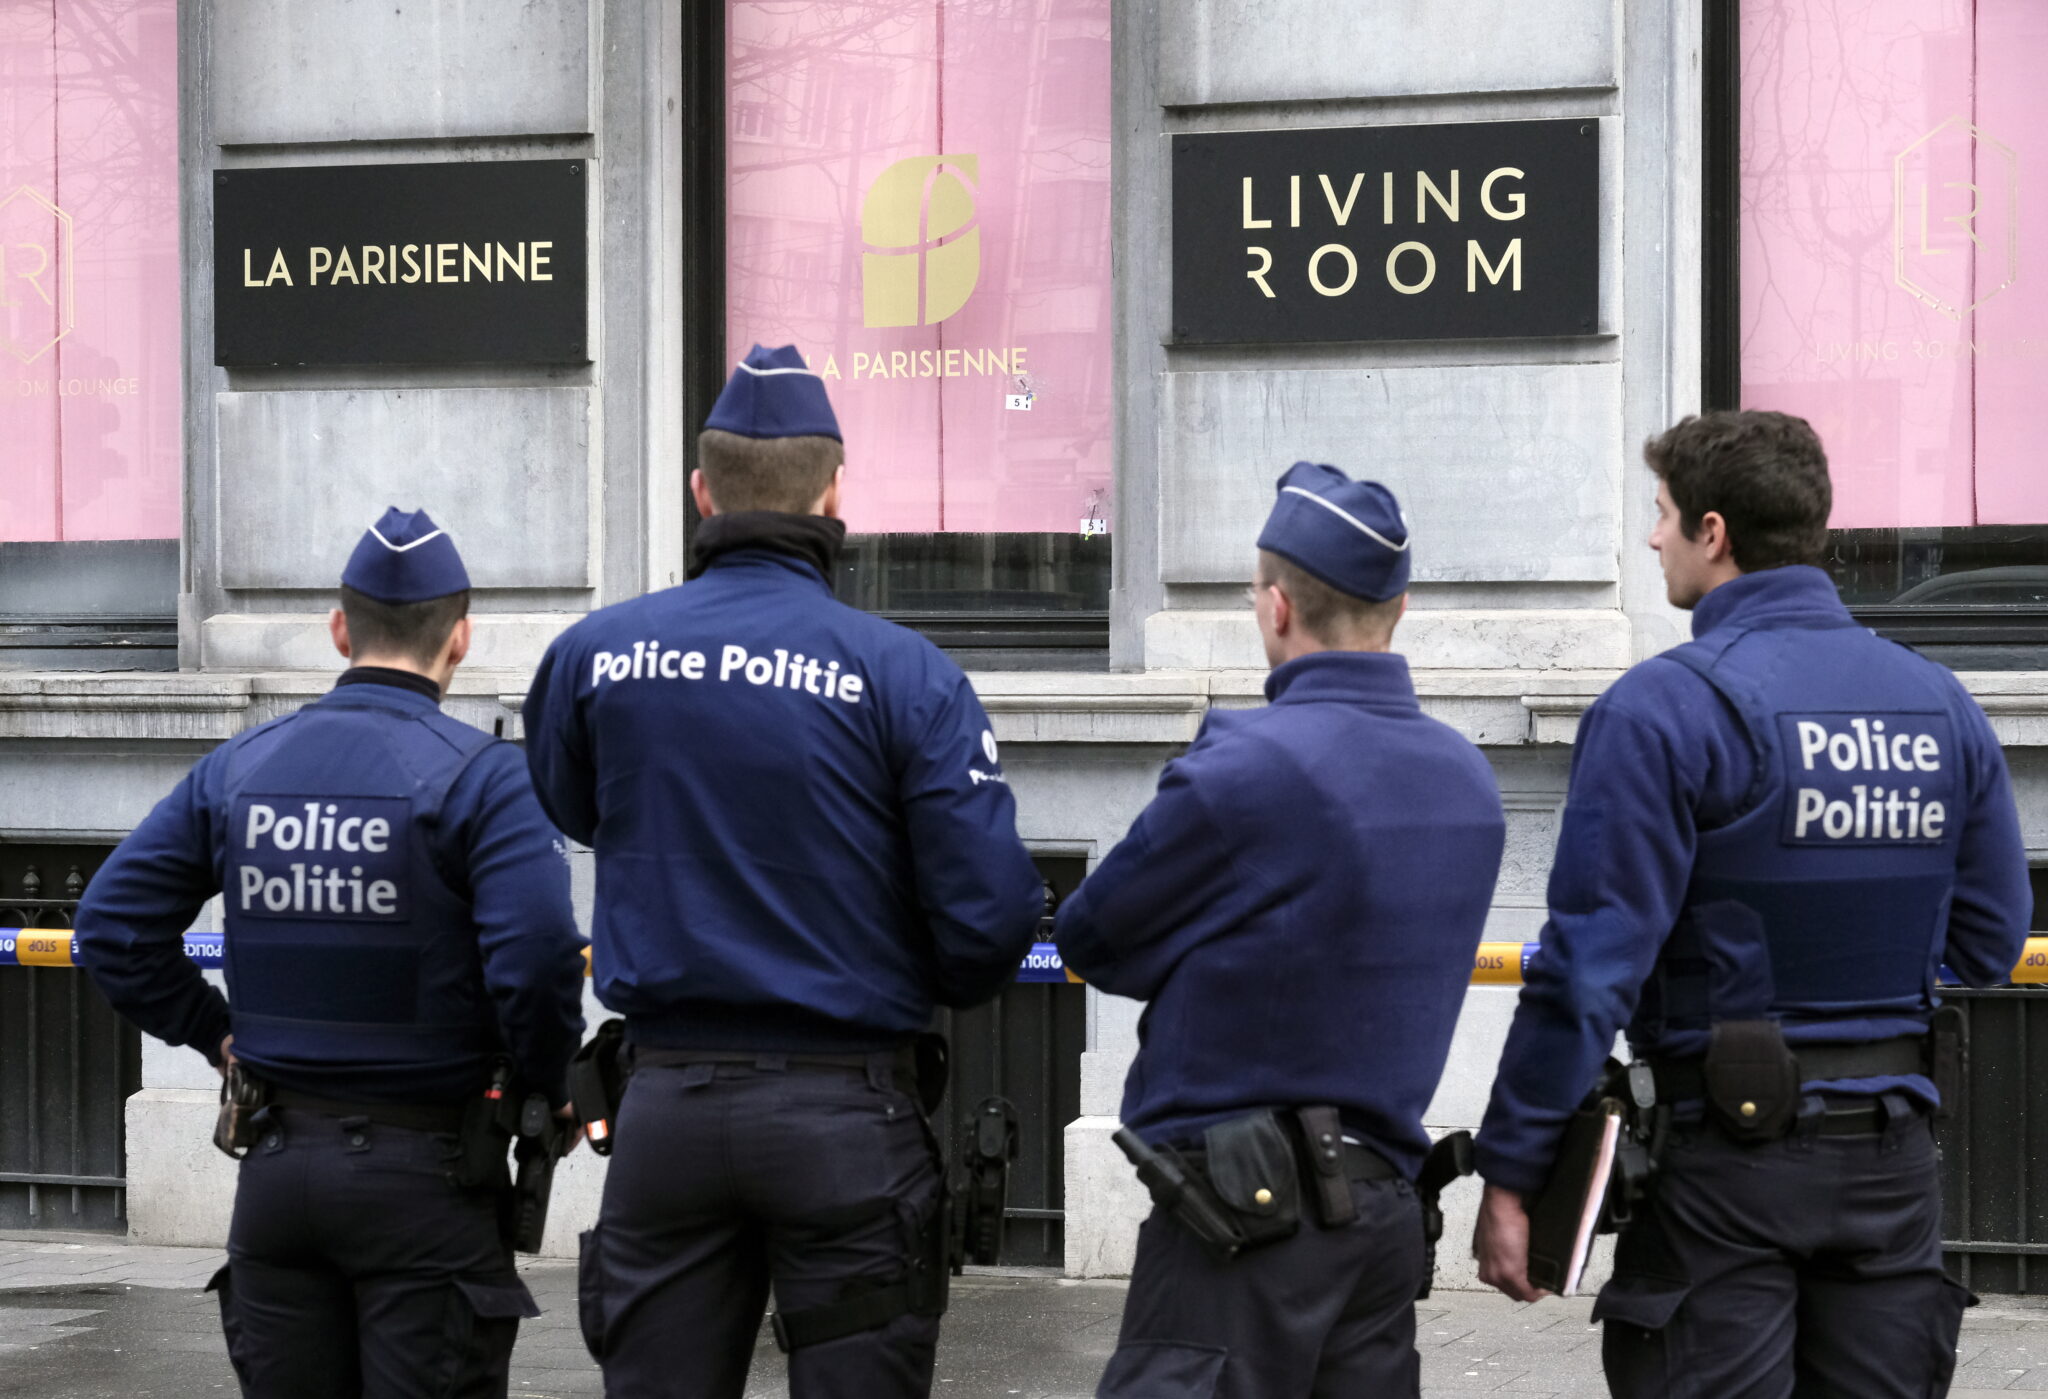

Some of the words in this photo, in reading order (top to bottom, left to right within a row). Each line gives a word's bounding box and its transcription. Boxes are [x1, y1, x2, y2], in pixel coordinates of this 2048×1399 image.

[1242, 166, 1527, 230] LIVING
[243, 246, 294, 288] LA
[309, 240, 553, 286] PARISIENNE
[1246, 237, 1522, 298] ROOM
[853, 347, 1028, 380] PARISIENNE
[1815, 341, 1899, 363] LIVING
[59, 377, 139, 396] LOUNGE
[592, 640, 706, 688] Police
[719, 645, 863, 703] Politie
[1797, 718, 1941, 772] Police
[245, 802, 391, 853] Police
[1795, 785, 1945, 839] Politie
[240, 863, 397, 915] Politie
[28, 940, 57, 953] STOP
[1020, 954, 1050, 969] POLI
[1477, 956, 1504, 969] STO
[2025, 953, 2048, 967] OP
